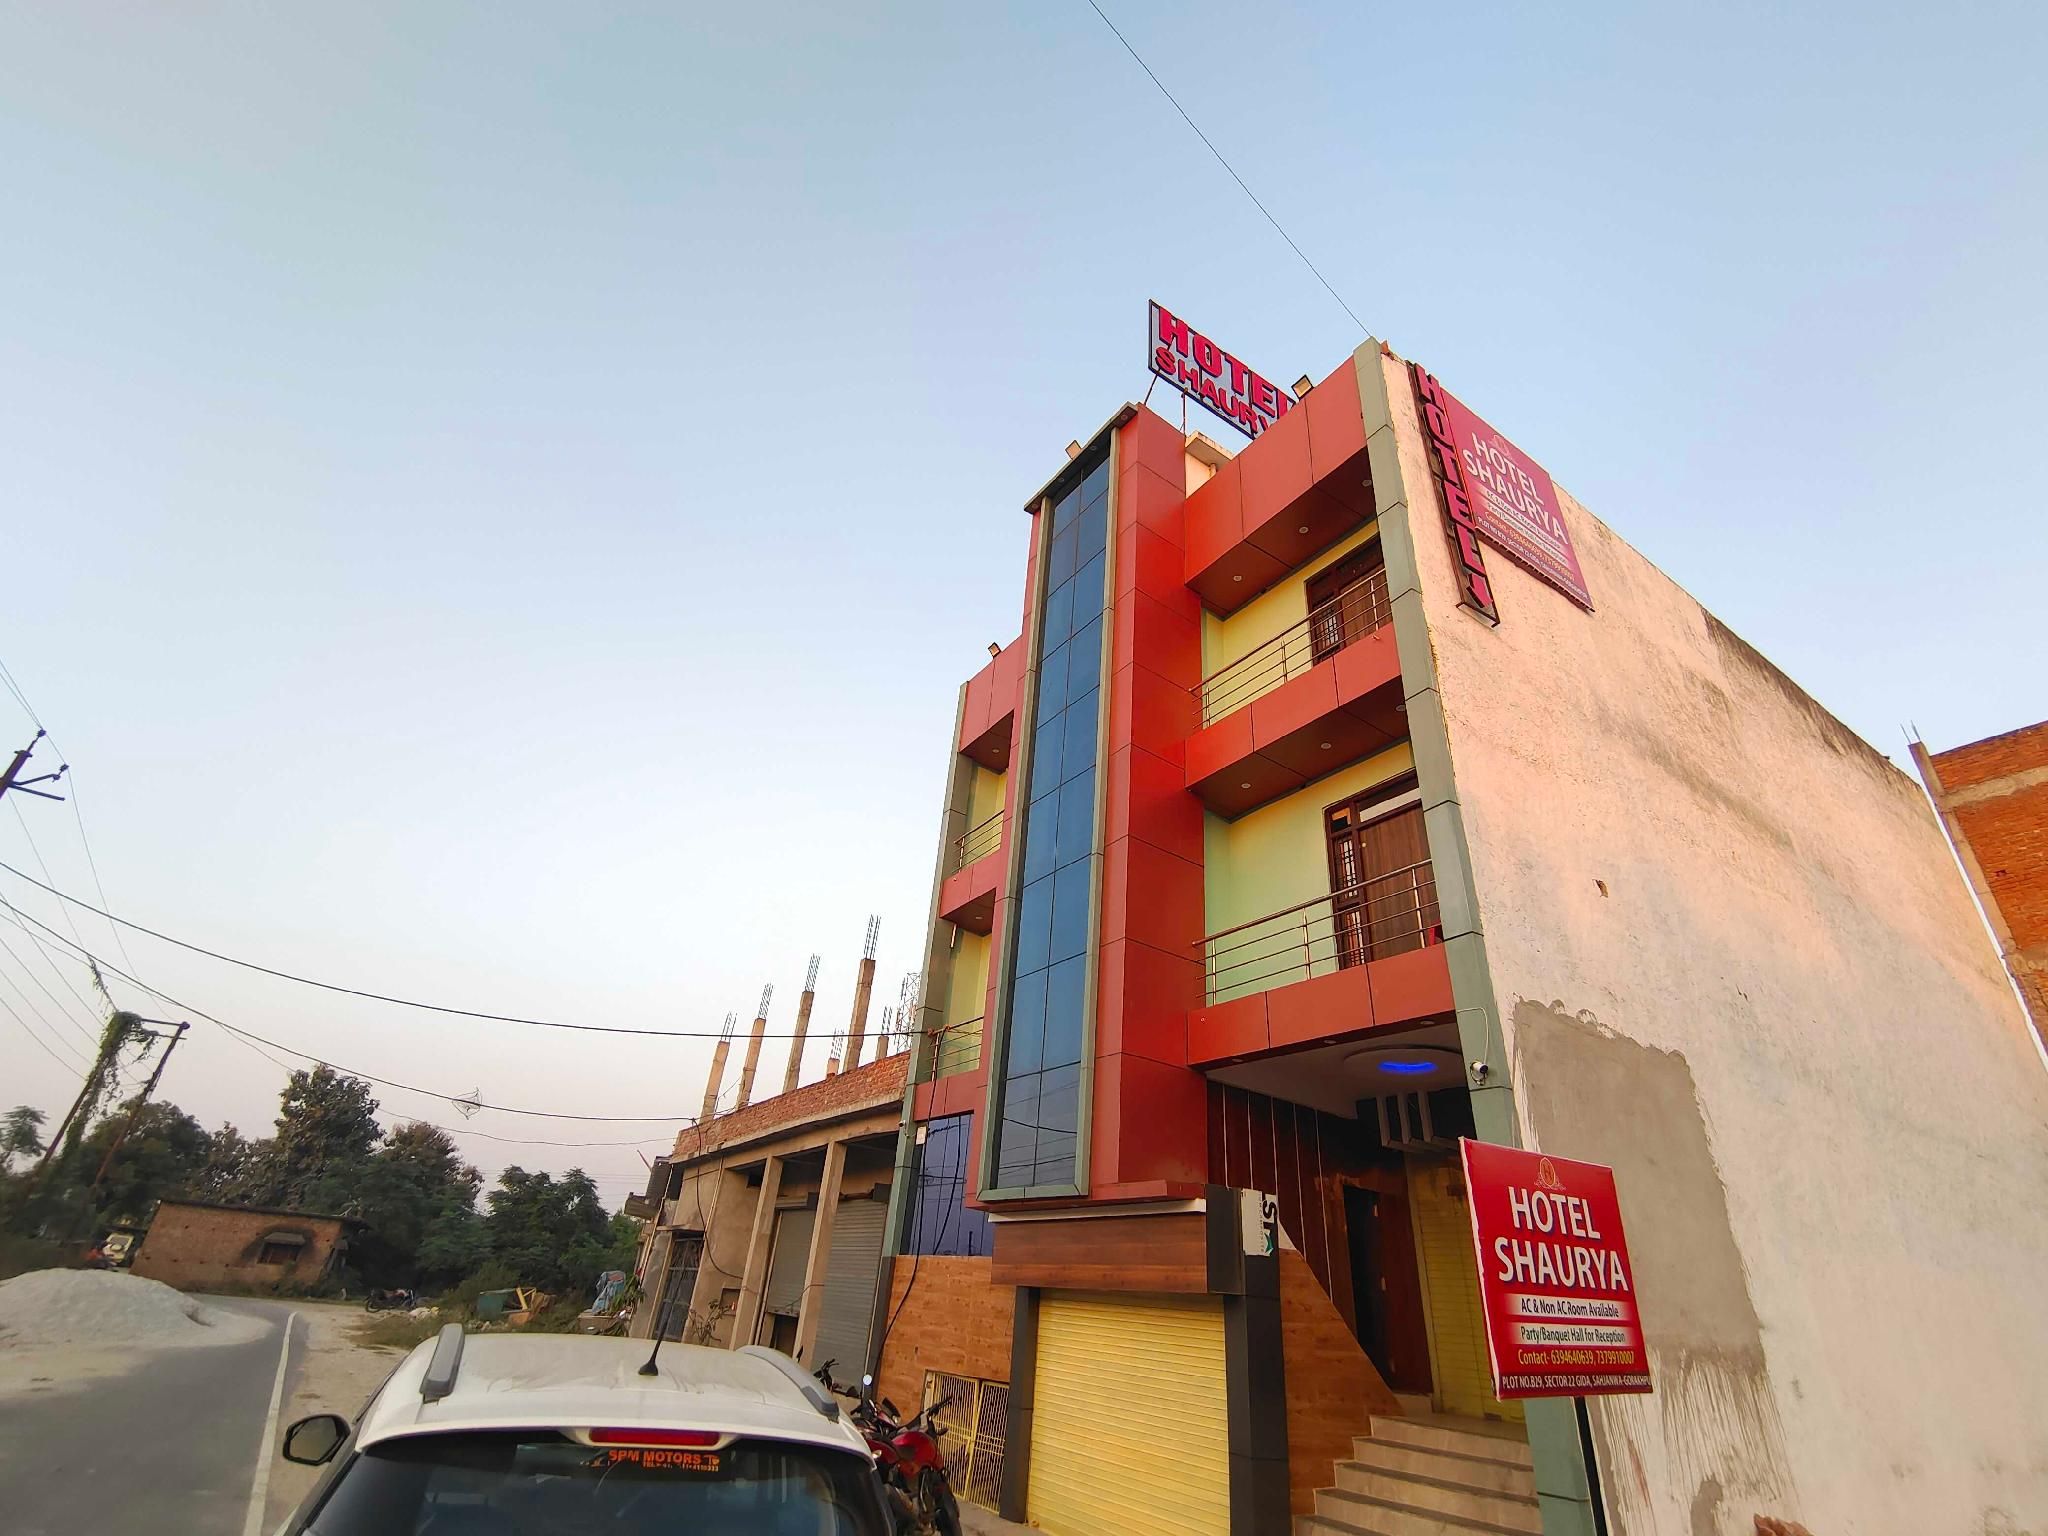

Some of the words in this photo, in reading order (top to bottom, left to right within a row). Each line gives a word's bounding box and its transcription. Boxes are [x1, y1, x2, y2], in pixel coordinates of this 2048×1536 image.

[1414, 362, 1485, 577] HOTEL
[1471, 431, 1544, 505] HOTEL
[1463, 449, 1569, 545] SHAURYA
[1508, 1186, 1601, 1239] HOTEL
[1494, 1237, 1629, 1291] SHAURYA
[1521, 1298, 1532, 1313] AC
[1533, 1299, 1540, 1313] &
[1540, 1299, 1555, 1314] Non
[1557, 1302, 1568, 1316] AC
[1568, 1303, 1588, 1316] Room
[1589, 1304, 1619, 1318] Available
[1521, 1326, 1570, 1344] Party/Banquet
[1571, 1328, 1583, 1342] Hall
[1584, 1329, 1594, 1342] for
[1595, 1330, 1626, 1345] Reception
[1502, 1375, 1519, 1389] PLOT
[1544, 1375, 1568, 1388] SECTOR
[608, 1450, 640, 1461] SPM
[643, 1451, 701, 1465] MOTORS
